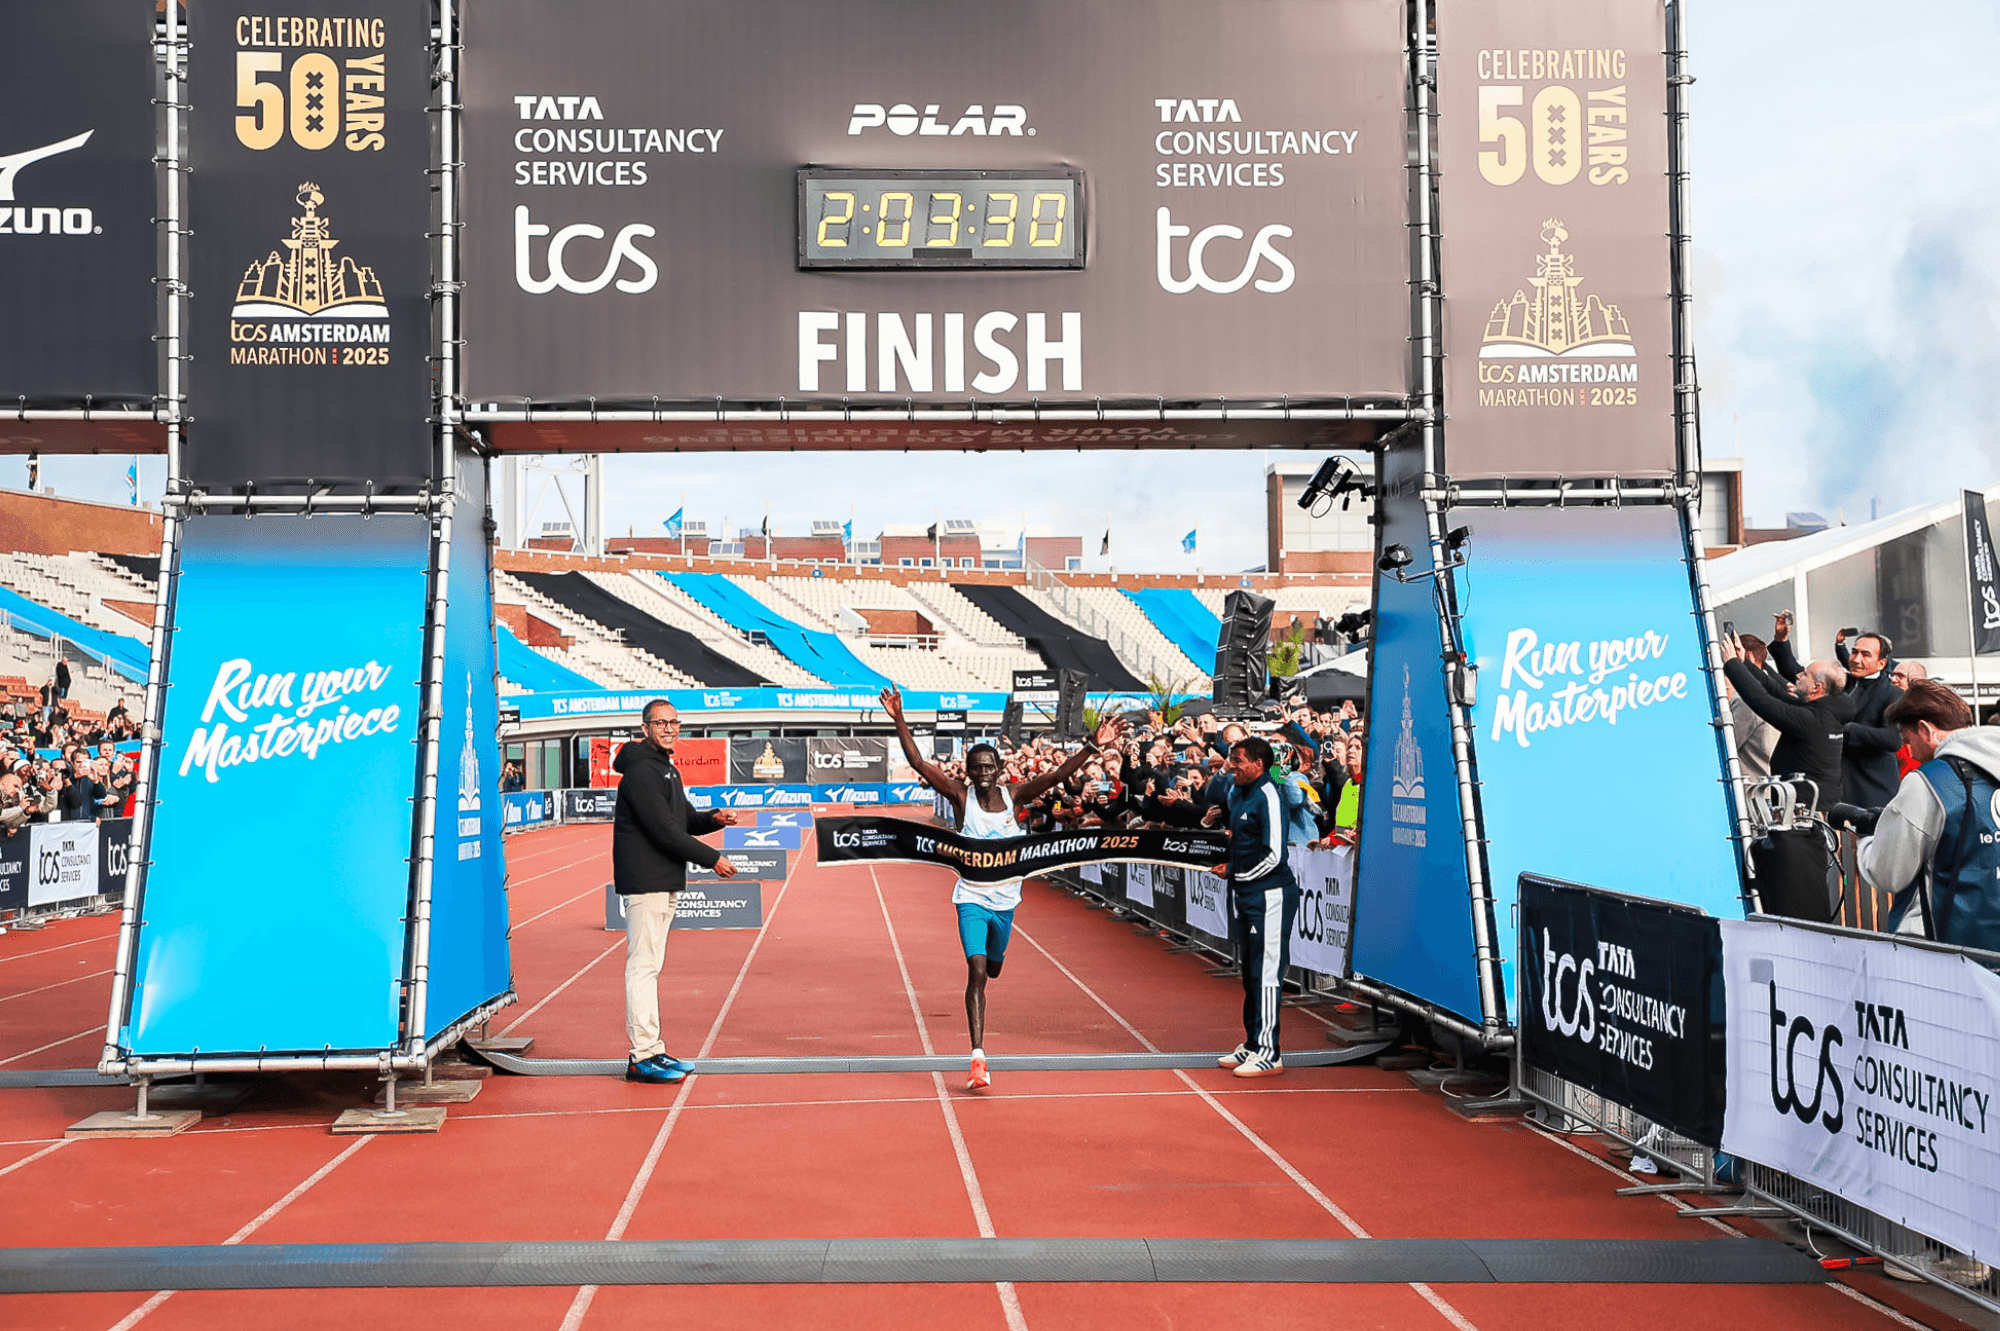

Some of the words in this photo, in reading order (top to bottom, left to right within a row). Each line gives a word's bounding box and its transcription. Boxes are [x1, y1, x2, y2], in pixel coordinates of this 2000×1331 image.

[236, 15, 386, 48] CELEBRATING
[1477, 49, 1627, 81] CELEBRATING
[235, 52, 341, 151] 50
[345, 55, 386, 152] YEARS
[514, 96, 604, 121] TATA
[1155, 99, 1242, 123] TATA
[514, 128, 724, 154] CONSULTANCY
[1155, 131, 1358, 155] CONSULTANCY
[1477, 85, 1582, 187] 50
[1587, 86, 1629, 186] YEARS
[514, 160, 648, 187] SERVICES
[1155, 162, 1285, 188] SERVICES
[816, 191, 1067, 247] 2:03:30
[515, 204, 659, 295] tcs
[1156, 206, 1296, 294] tcs
[230, 319, 268, 344] tcs
[269, 322, 390, 344] AMSTERDAM
[230, 347, 327, 366] MARATHON
[342, 346, 390, 366] 2025
[799, 310, 1083, 395] FINISH
[1478, 359, 1516, 384] tcs
[1517, 362, 1638, 384] AMSTERDAM
[1478, 387, 1575, 407] MARATHON
[1590, 387, 1638, 406] 2025
[1501, 628, 1583, 690] Run
[1587, 630, 1669, 685] your
[201, 658, 295, 723] Run
[296, 660, 392, 715] your
[552, 698, 568, 714] TCS
[569, 695, 620, 713] AMSTERDAM
[1490, 671, 1688, 748] Masterpiece
[178, 703, 400, 783] Masterpiece
[814, 750, 842, 768] tcs
[575, 796, 594, 812] tcs
[833, 830, 860, 848] tcs
[916, 835, 935, 854] TCS
[936, 842, 1017, 868] AMSTERDAM
[1019, 836, 1099, 862] MARATHON
[1100, 835, 1140, 849] 2025
[1162, 837, 1189, 853] tcs
[1980, 832, 1993, 844] le
[38, 844, 60, 886] tcs
[107, 836, 128, 877] tcs
[675, 891, 707, 900] TATA
[1325, 876, 1340, 896] TATA
[675, 899, 748, 909] CONSULTANCY
[675, 909, 722, 918] SERVICES
[1597, 941, 1635, 980] TATA
[1542, 927, 1595, 1044] tcs
[1599, 981, 1686, 1040] CONSULTANCY
[1855, 1000, 1909, 1050] TATA
[1598, 1023, 1653, 1071] SERVICES
[1769, 979, 1844, 1135] tcs
[1853, 1053, 1990, 1135] CONSULTANCY
[1855, 1107, 1939, 1174] SERVICES
